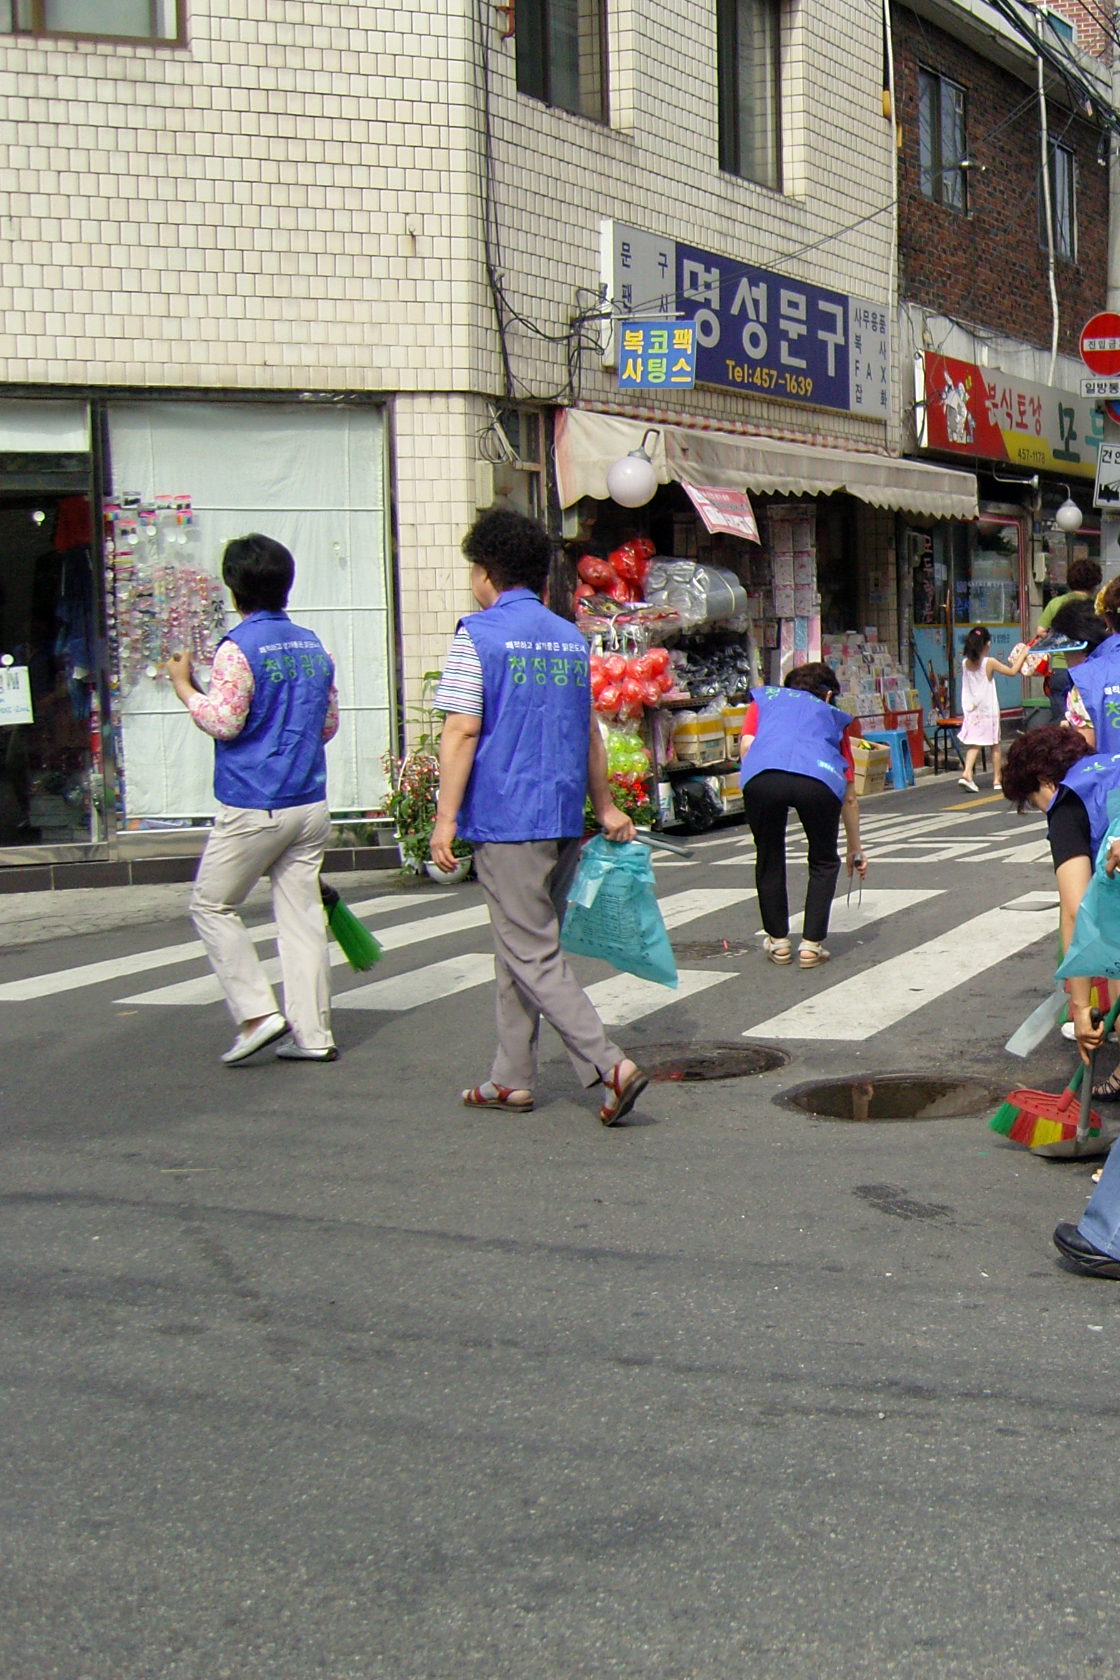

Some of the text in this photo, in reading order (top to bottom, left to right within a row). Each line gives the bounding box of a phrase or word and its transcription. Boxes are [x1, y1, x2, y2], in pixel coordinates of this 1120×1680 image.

[682, 258, 846, 378] 명성문구
[855, 307, 886, 335] 사무용품
[622, 329, 645, 383] 복사
[647, 329, 669, 383] 코팅
[670, 328, 693, 383] 팩스
[726, 359, 814, 397] Tel:457-1639
[508, 656, 589, 687] 청정광진
